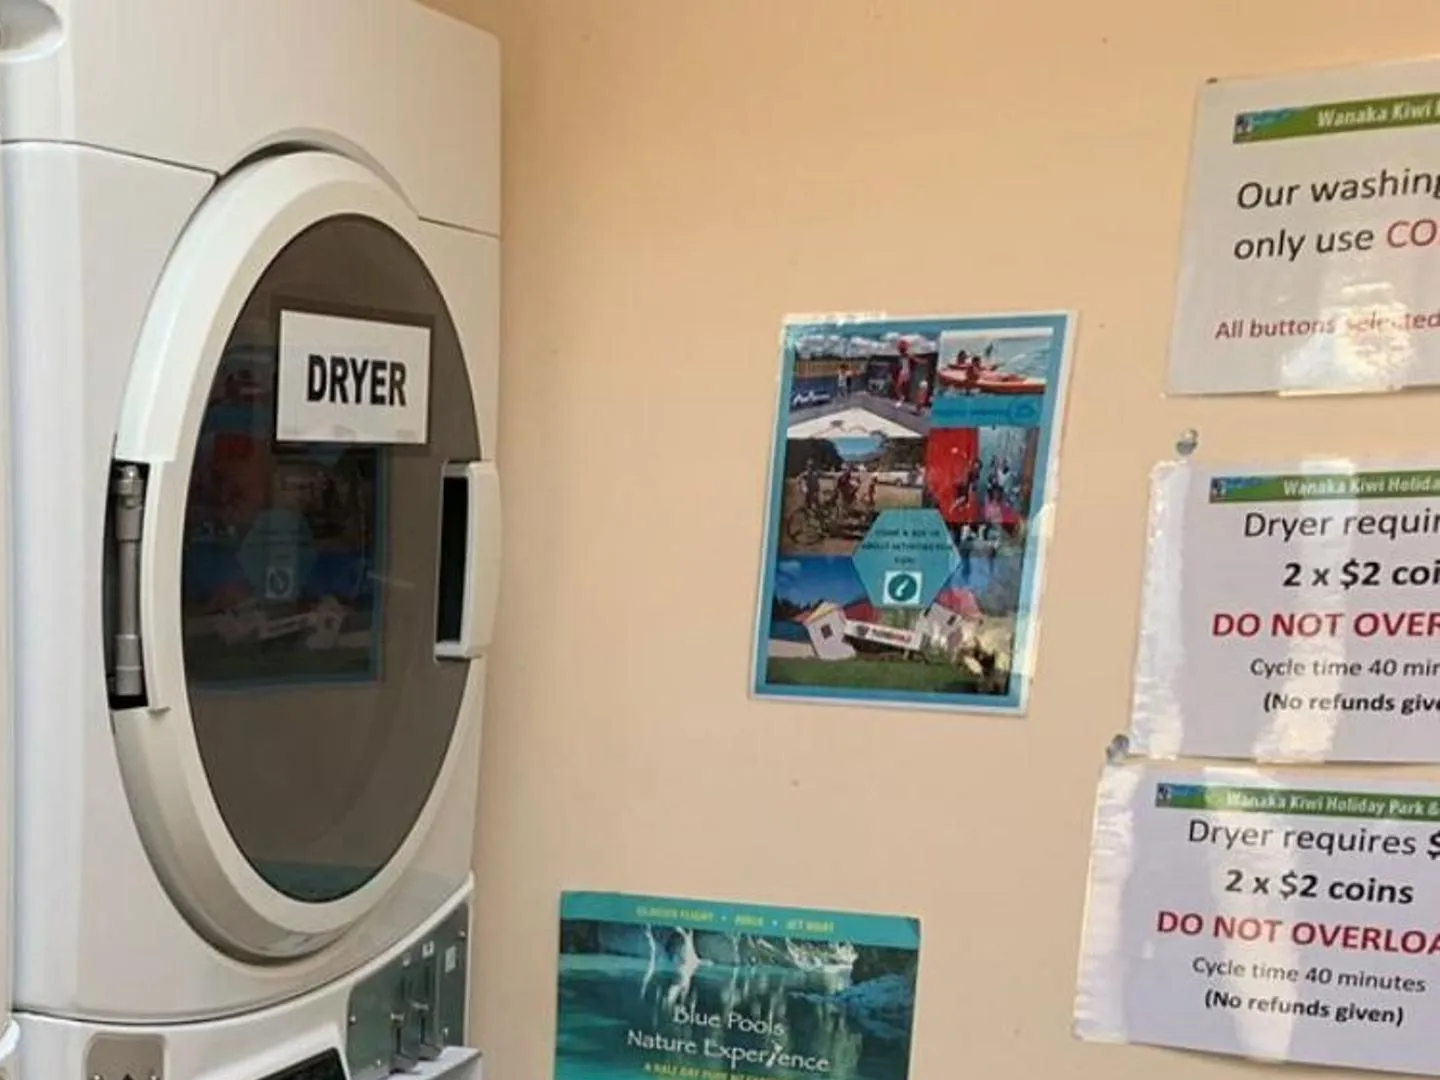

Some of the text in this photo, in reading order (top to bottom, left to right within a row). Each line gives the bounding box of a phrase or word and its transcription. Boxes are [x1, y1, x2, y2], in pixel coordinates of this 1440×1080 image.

[1317, 106, 1387, 128] Wanaka
[1391, 100, 1431, 121] Kiwi
[1237, 182, 1301, 209] Our
[1233, 229, 1305, 262] only
[1316, 229, 1374, 253] use
[1215, 310, 1440, 339] All buttons seleted
[306, 354, 407, 407] DRYER
[1283, 478, 1346, 496] Wanaka
[1350, 477, 1384, 493] Kiwi
[1244, 512, 1333, 542] Dryer
[1283, 563, 1301, 587] 2
[1311, 567, 1329, 586] x
[1340, 558, 1381, 590] $2
[1213, 613, 1260, 637] DO
[1271, 612, 1344, 637] NOT
[1250, 657, 1306, 679] Cycle
[1312, 657, 1362, 677] time
[1367, 658, 1397, 677] 40
[1263, 691, 1303, 712] (No
[1309, 691, 1395, 711] refunds
[1225, 791, 1285, 810] Wanaka
[1290, 795, 1323, 811] Kiwi
[1327, 796, 1385, 816] Holiday
[1388, 799, 1424, 815] Park
[1188, 819, 1273, 850] Dryer
[1283, 827, 1416, 856] requires
[1224, 869, 1415, 905] 2 x $2 coins
[1156, 911, 1203, 936] DO
[1213, 916, 1283, 943] NOT
[1192, 956, 1426, 993] Cycle time 40 minutes
[673, 1003, 785, 1037] Blue Pools
[1205, 989, 1404, 1027] (No refunds given)
[626, 1030, 832, 1073] Nature Experience
